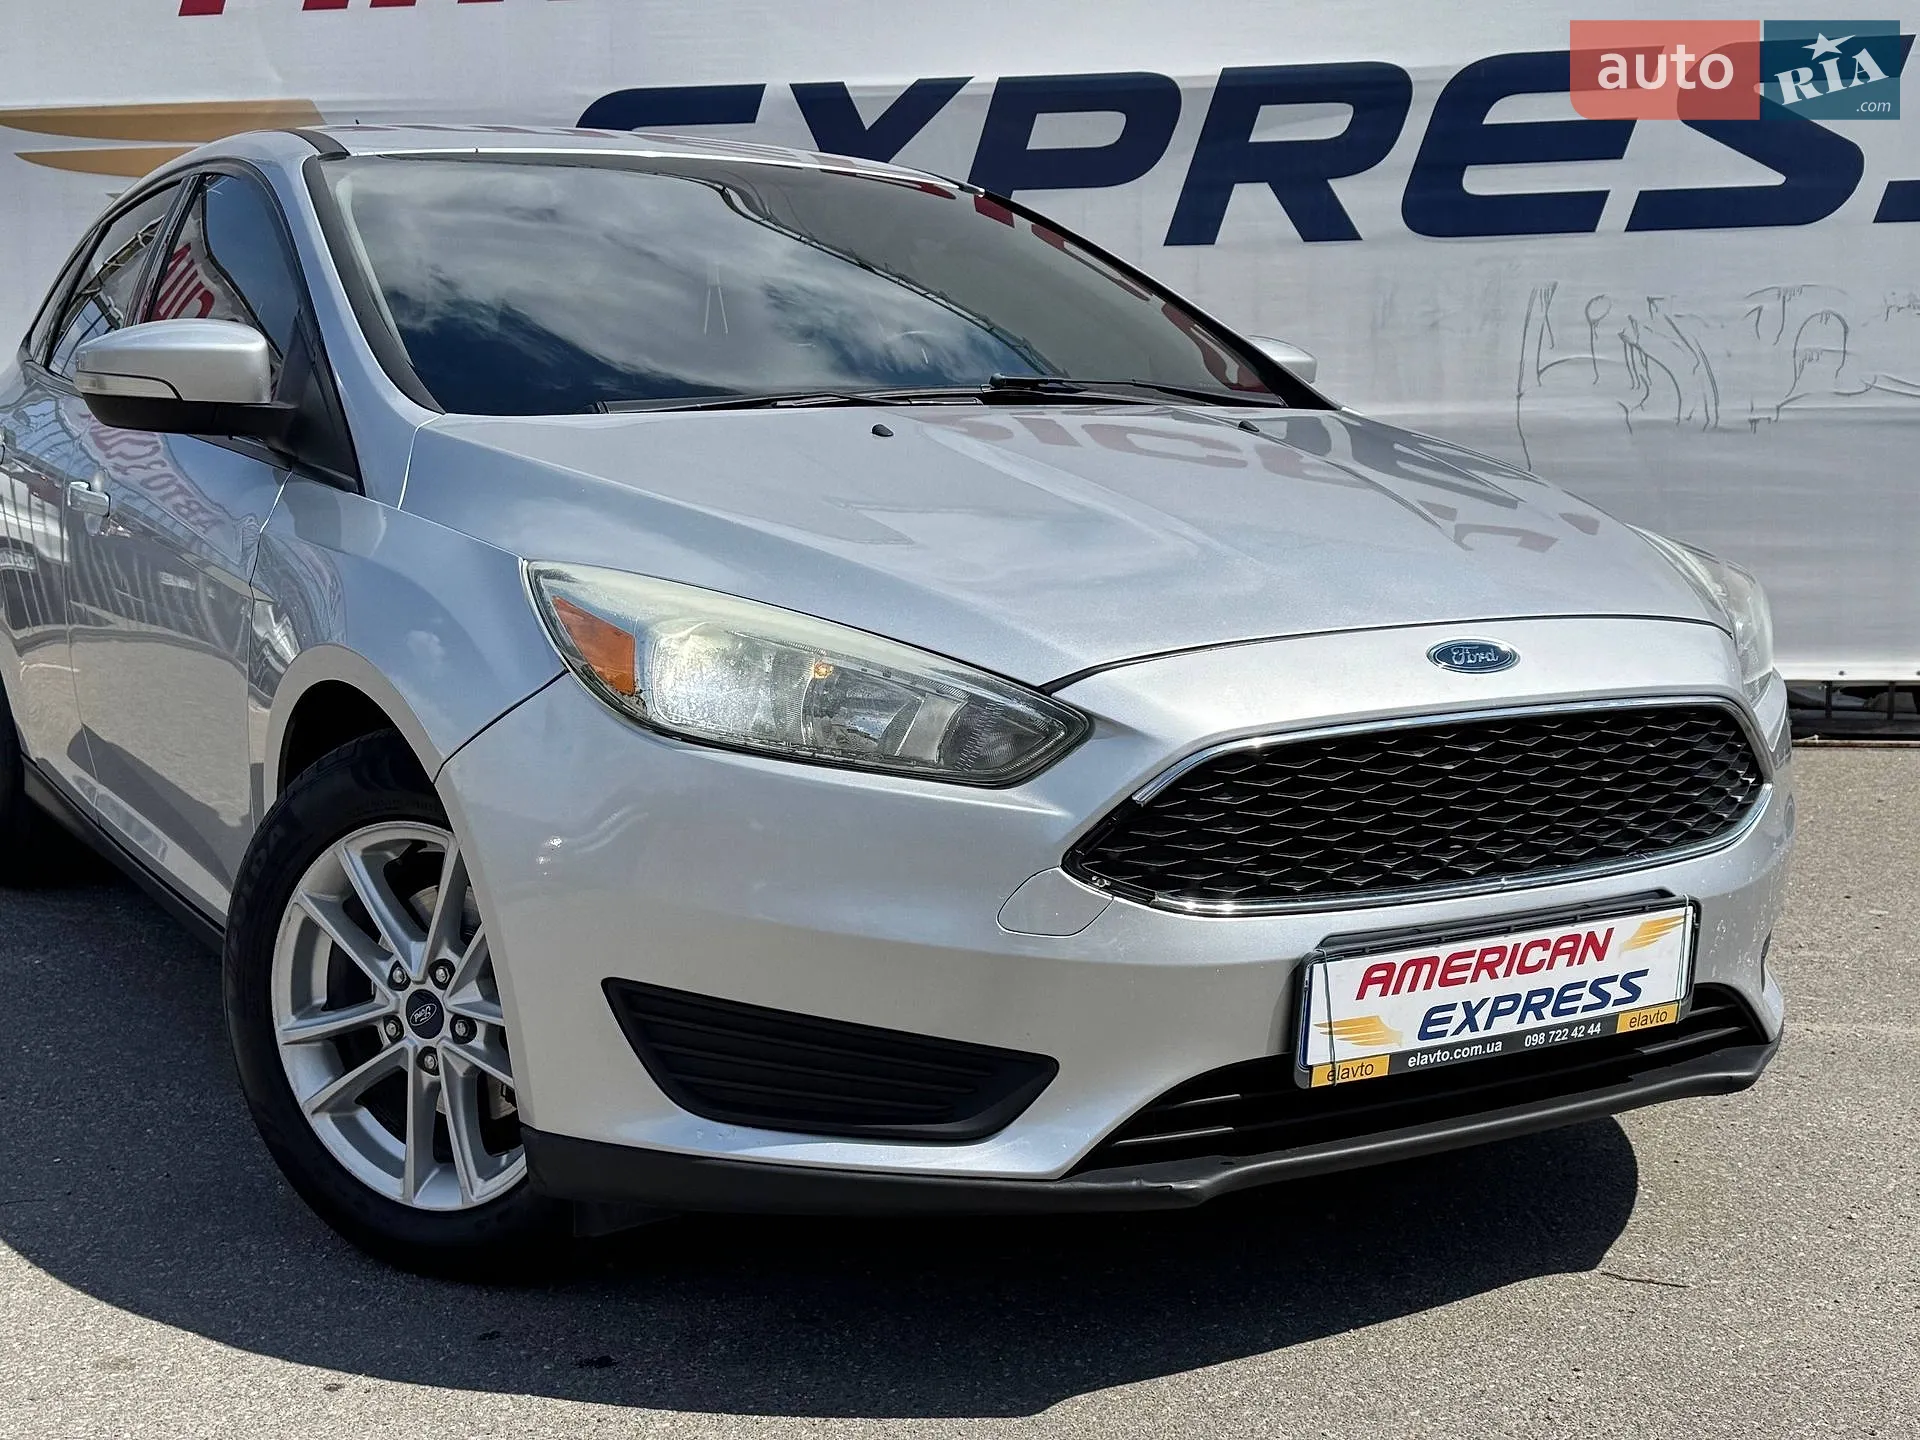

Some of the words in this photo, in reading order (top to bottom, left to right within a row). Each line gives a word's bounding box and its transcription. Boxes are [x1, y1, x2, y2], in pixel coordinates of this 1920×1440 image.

[1451, 645, 1500, 665] Ford
[1355, 927, 1615, 1001] AMERICAN
[1417, 969, 1650, 1041] EXPRESS
[1629, 1009, 1668, 1029] elavto
[1524, 1034, 1546, 1047] 098
[1549, 1029, 1569, 1042] 722
[1571, 1025, 1585, 1038] 42
[1587, 1023, 1601, 1035] 44
[1407, 1040, 1503, 1068] elavto.com.ua
[1326, 1062, 1374, 1082] elavto
